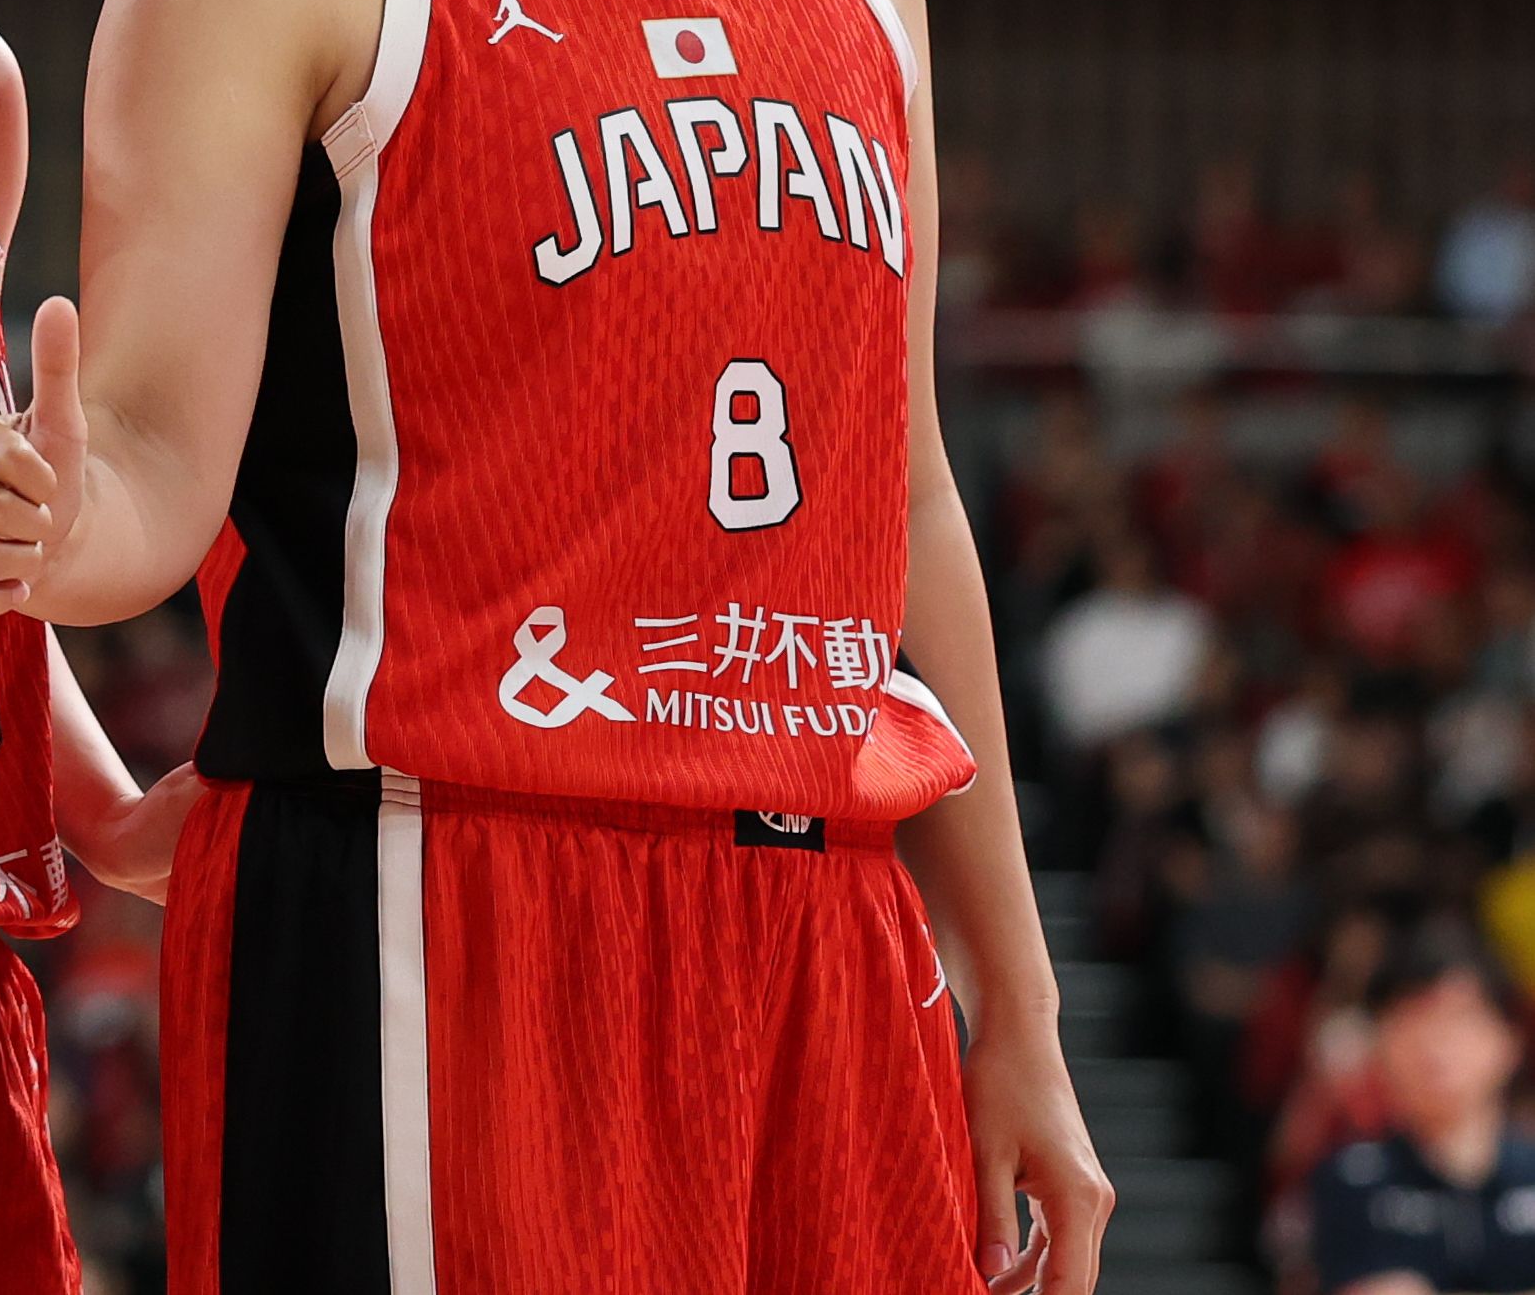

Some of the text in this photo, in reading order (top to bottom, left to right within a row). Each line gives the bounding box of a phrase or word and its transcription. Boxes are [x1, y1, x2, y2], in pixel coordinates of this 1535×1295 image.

[533, 96, 905, 289] JAPAN
[707, 357, 803, 534] 8
[645, 687, 776, 737] MITSUI
